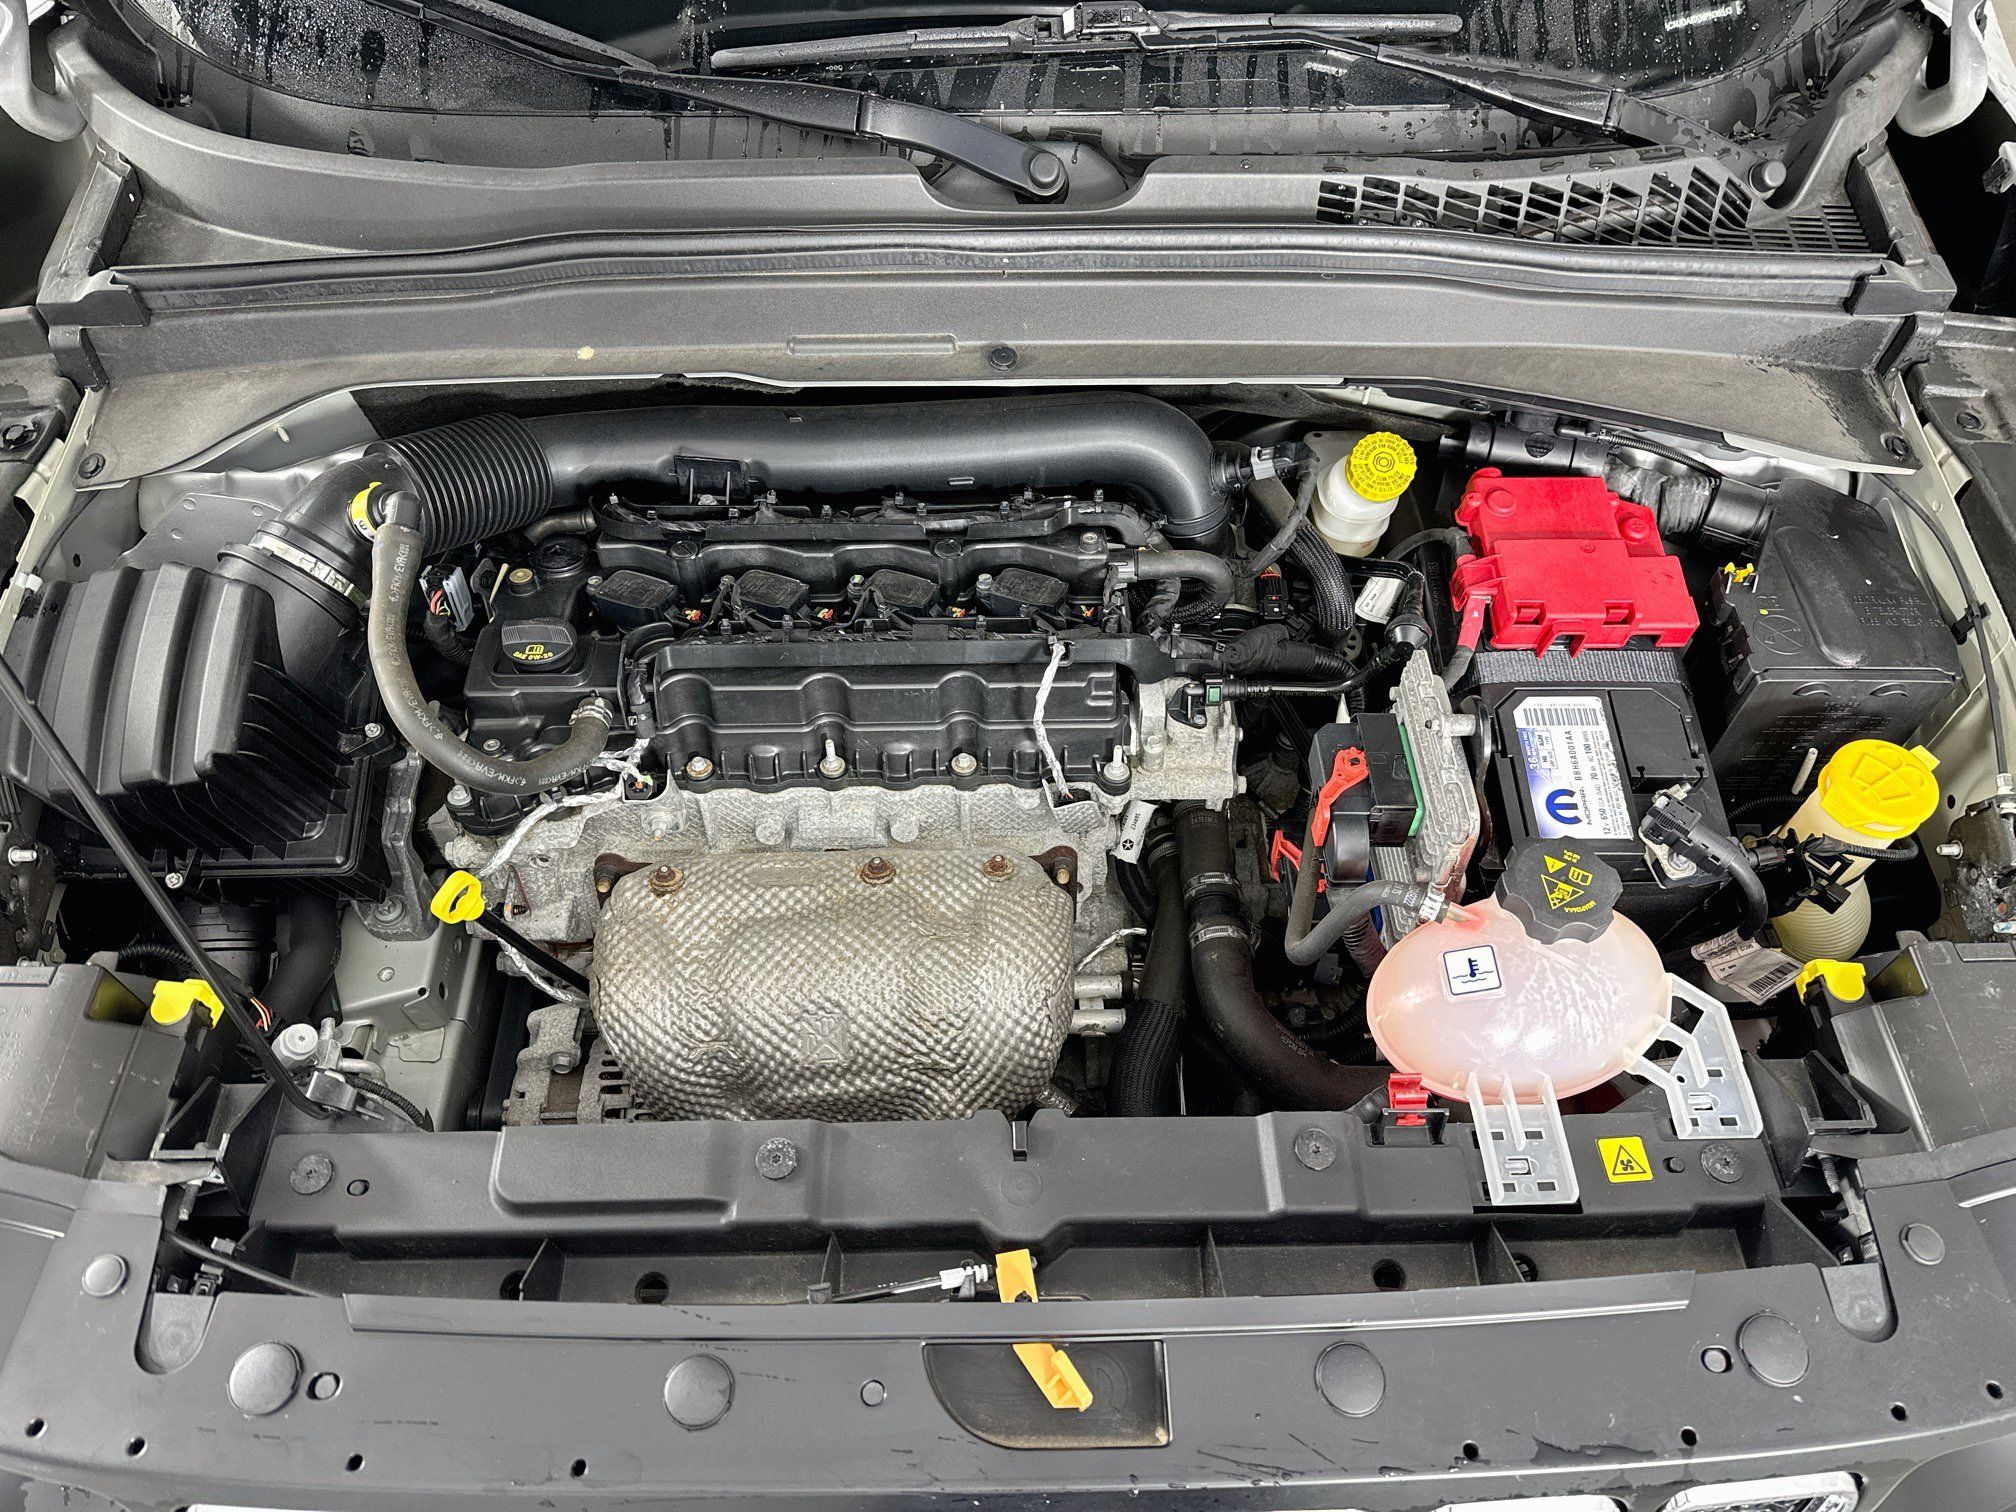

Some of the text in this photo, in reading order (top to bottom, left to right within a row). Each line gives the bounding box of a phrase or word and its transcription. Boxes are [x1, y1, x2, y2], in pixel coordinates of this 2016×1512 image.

[513, 652, 553, 660] SAE 0W-20
[1529, 756, 1540, 769] 36
[1591, 772, 1598, 780] 70
[1579, 789, 1592, 825] MOPAR
[1599, 808, 1607, 820] 650
